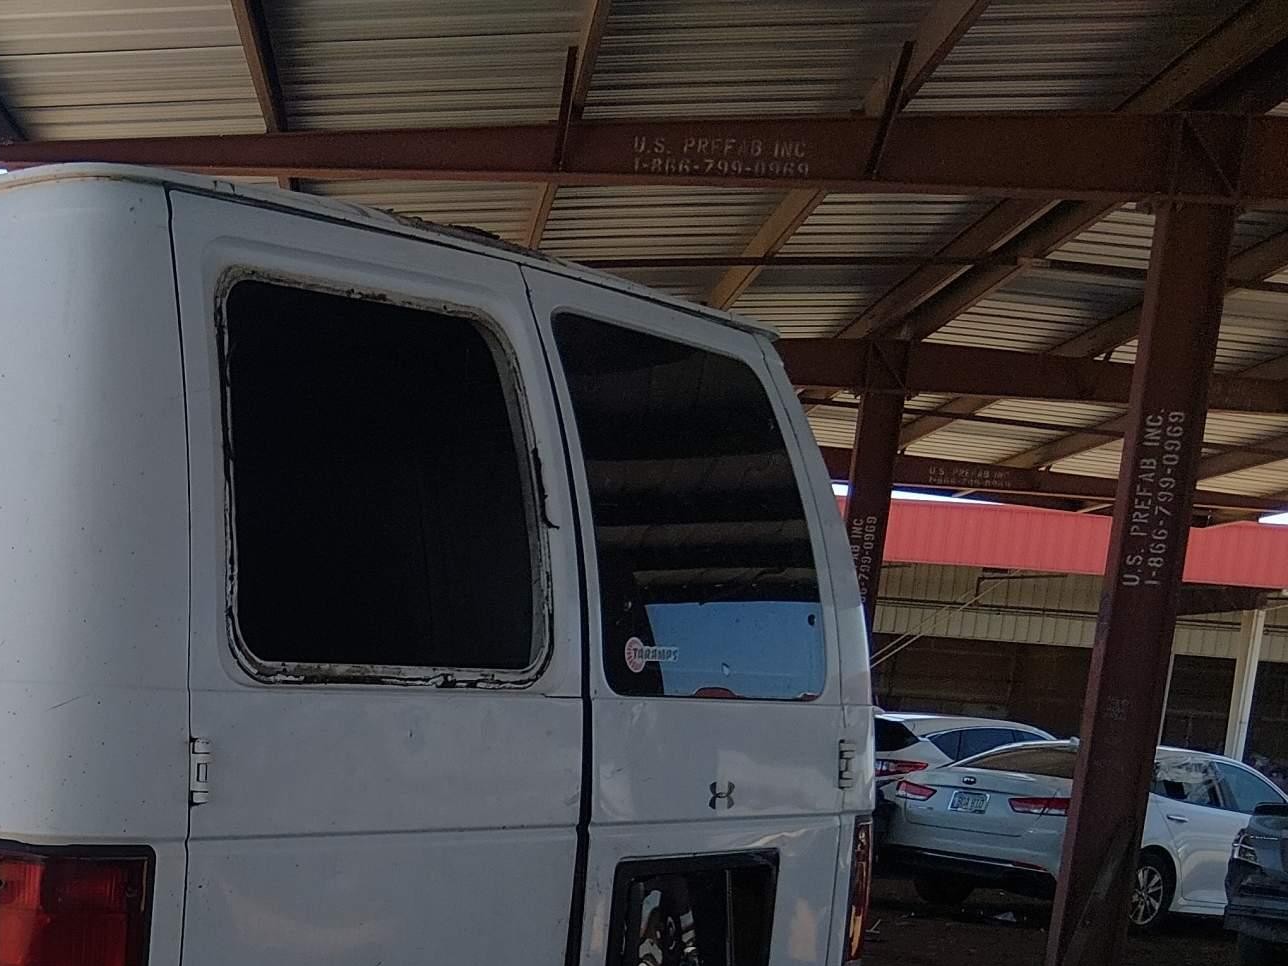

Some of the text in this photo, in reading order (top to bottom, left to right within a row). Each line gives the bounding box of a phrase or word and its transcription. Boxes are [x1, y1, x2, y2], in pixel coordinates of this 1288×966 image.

[1129, 458, 1157, 536] PREFAB
[1145, 411, 1185, 585] 1-866-799-0969
[1122, 549, 1144, 586] U.S.
